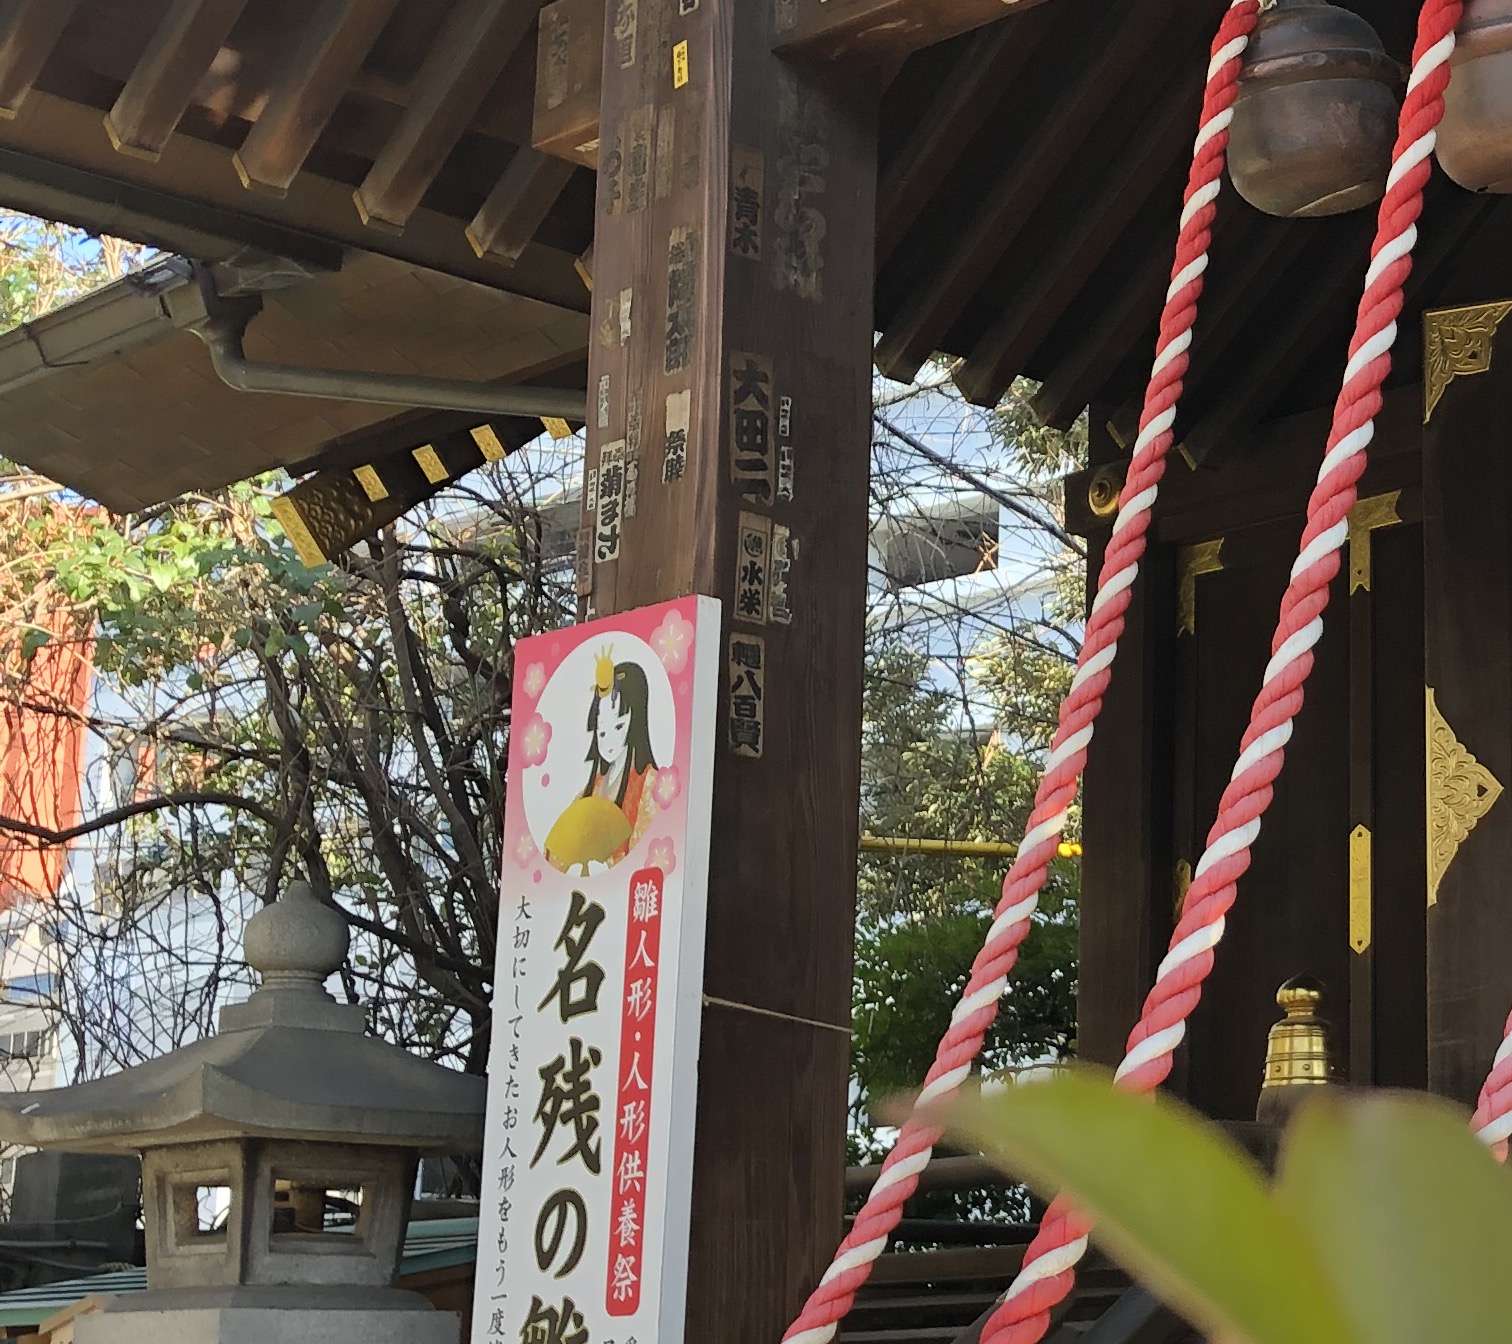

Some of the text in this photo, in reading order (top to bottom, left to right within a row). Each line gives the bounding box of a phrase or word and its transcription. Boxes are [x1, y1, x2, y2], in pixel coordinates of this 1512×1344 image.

[610, 881, 660, 1302] 雛人形・人形供養祭
